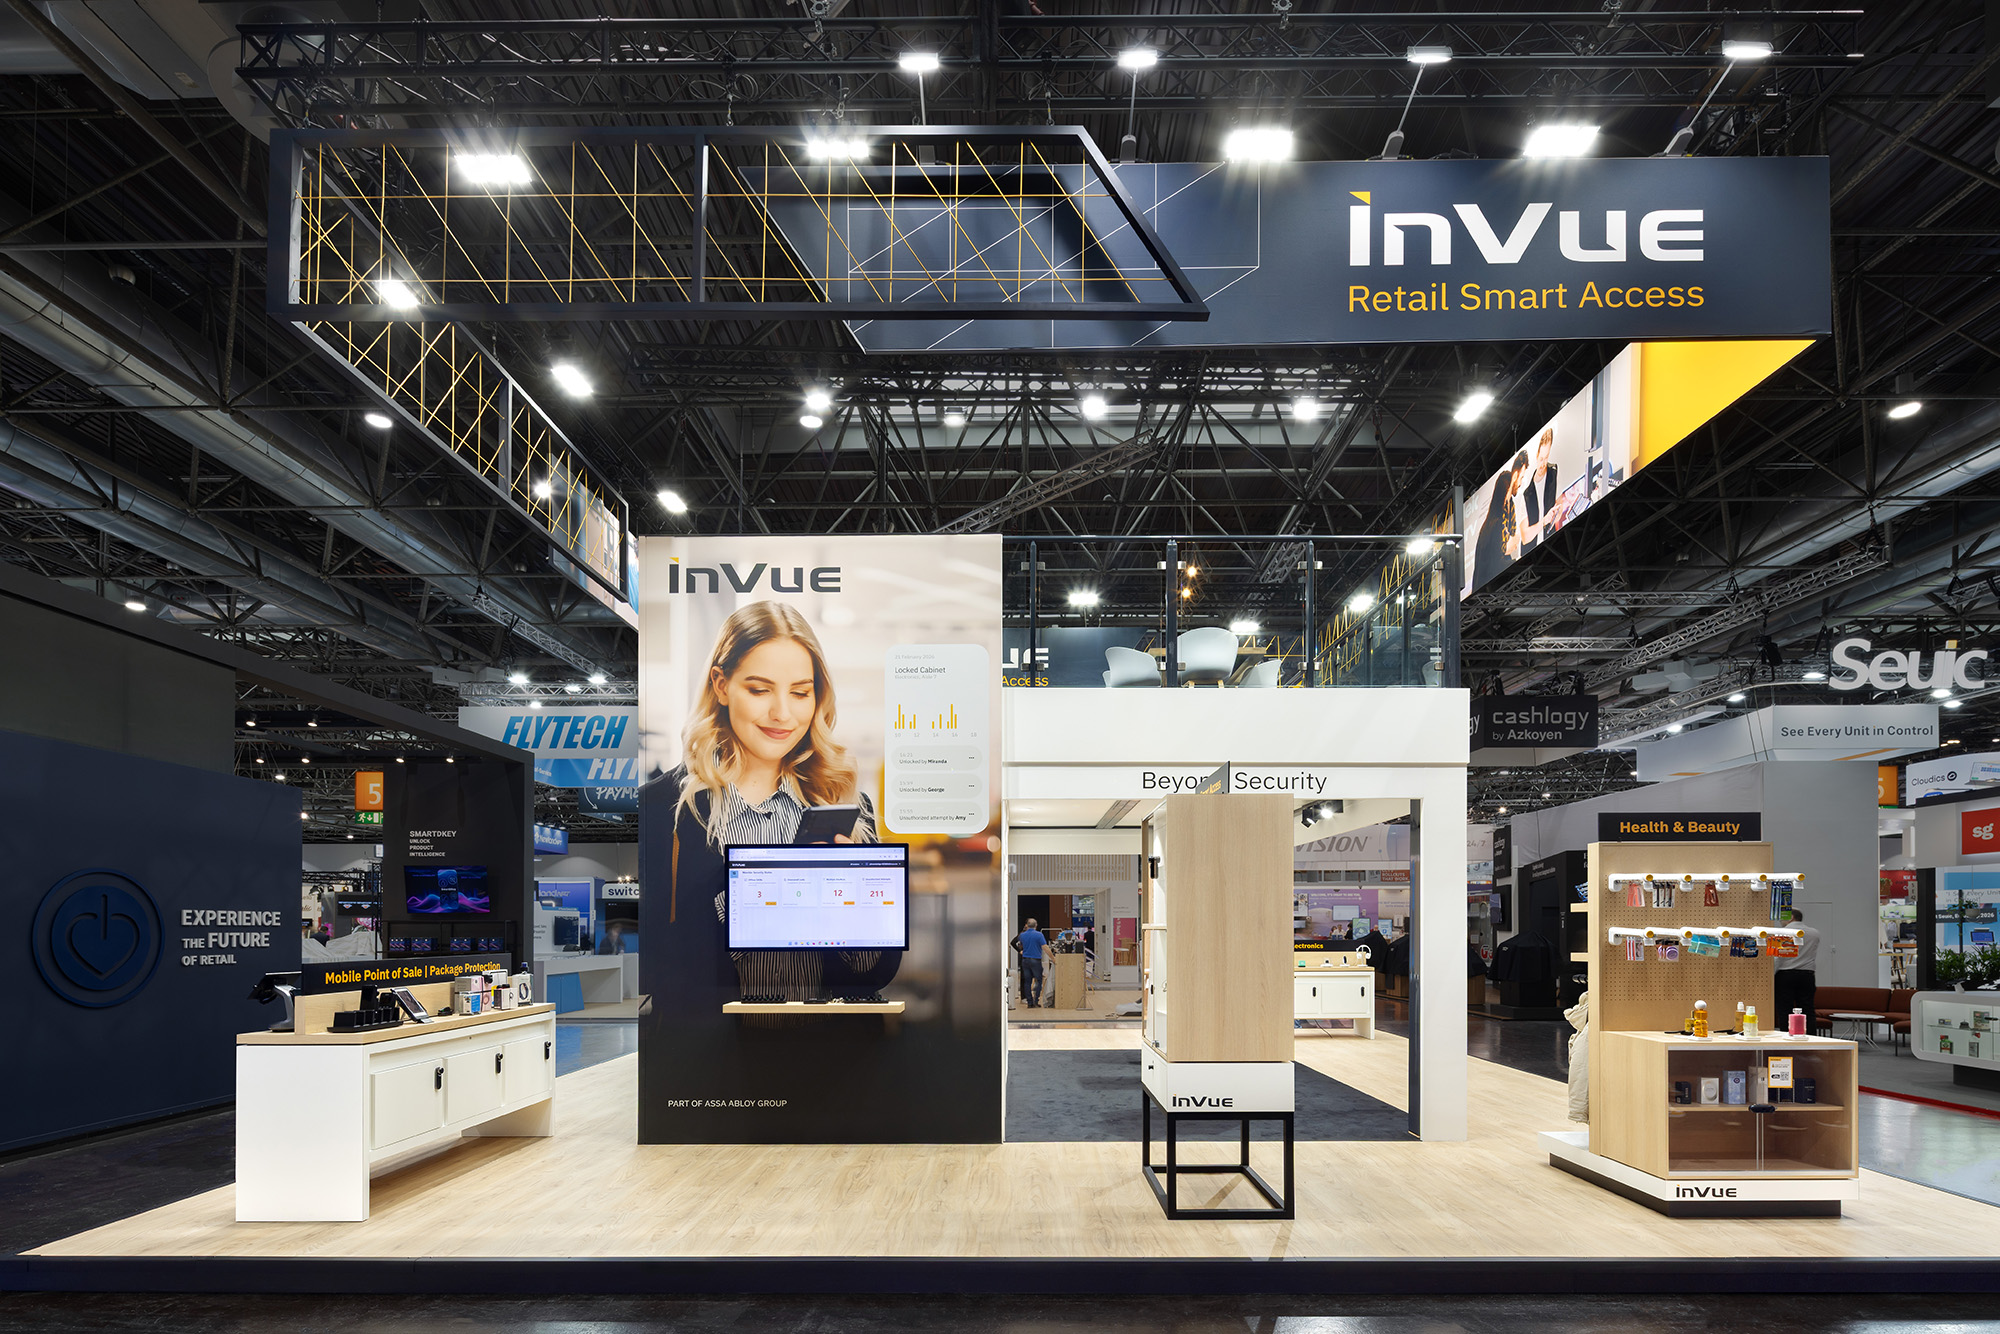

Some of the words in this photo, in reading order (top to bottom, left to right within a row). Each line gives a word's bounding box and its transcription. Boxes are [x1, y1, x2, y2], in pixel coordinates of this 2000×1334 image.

[1349, 282, 1449, 312] Retail
[1460, 283, 1568, 311] Smart
[1578, 281, 1705, 309] Access
[920, 666, 946, 674] Cabinet
[1829, 638, 1988, 690] Seuic
[1492, 706, 1590, 731] cashlogy
[502, 715, 629, 749] FLYTECH
[1492, 732, 1505, 741] by
[1507, 729, 1563, 742] Azkoyen
[1781, 727, 1804, 737] See
[1808, 727, 1842, 738] Every
[1845, 726, 1870, 736] Unit
[1873, 725, 1884, 736] in
[1887, 725, 1934, 736] Control
[1234, 771, 1327, 793] Security
[1912, 775, 1945, 786] Cloudics
[369, 783, 381, 805] 5
[1620, 821, 1668, 833] Health
[1673, 821, 1684, 833] &
[1688, 821, 1740, 835] Beauty
[1972, 823, 1994, 840] sg
[757, 890, 762, 898] 3
[834, 889, 843, 897] 12
[181, 909, 281, 926] EXPERIENCE
[182, 938, 205, 949] THE
[208, 932, 270, 948] FUTURE
[181, 955, 198, 966] OF
[200, 954, 237, 965] RETAIL
[325, 968, 361, 985] Mobile
[364, 968, 390, 982] Point
[391, 967, 401, 980] of
[402, 965, 422, 979] Sale
[429, 964, 463, 977] Package
[464, 961, 500, 973] Protection
[667, 1100, 689, 1108] PART
[691, 1100, 703, 1108] OF
[704, 1100, 727, 1108] ASSA
[728, 1100, 756, 1108] ABLOY
[757, 1100, 788, 1108] GROUP
